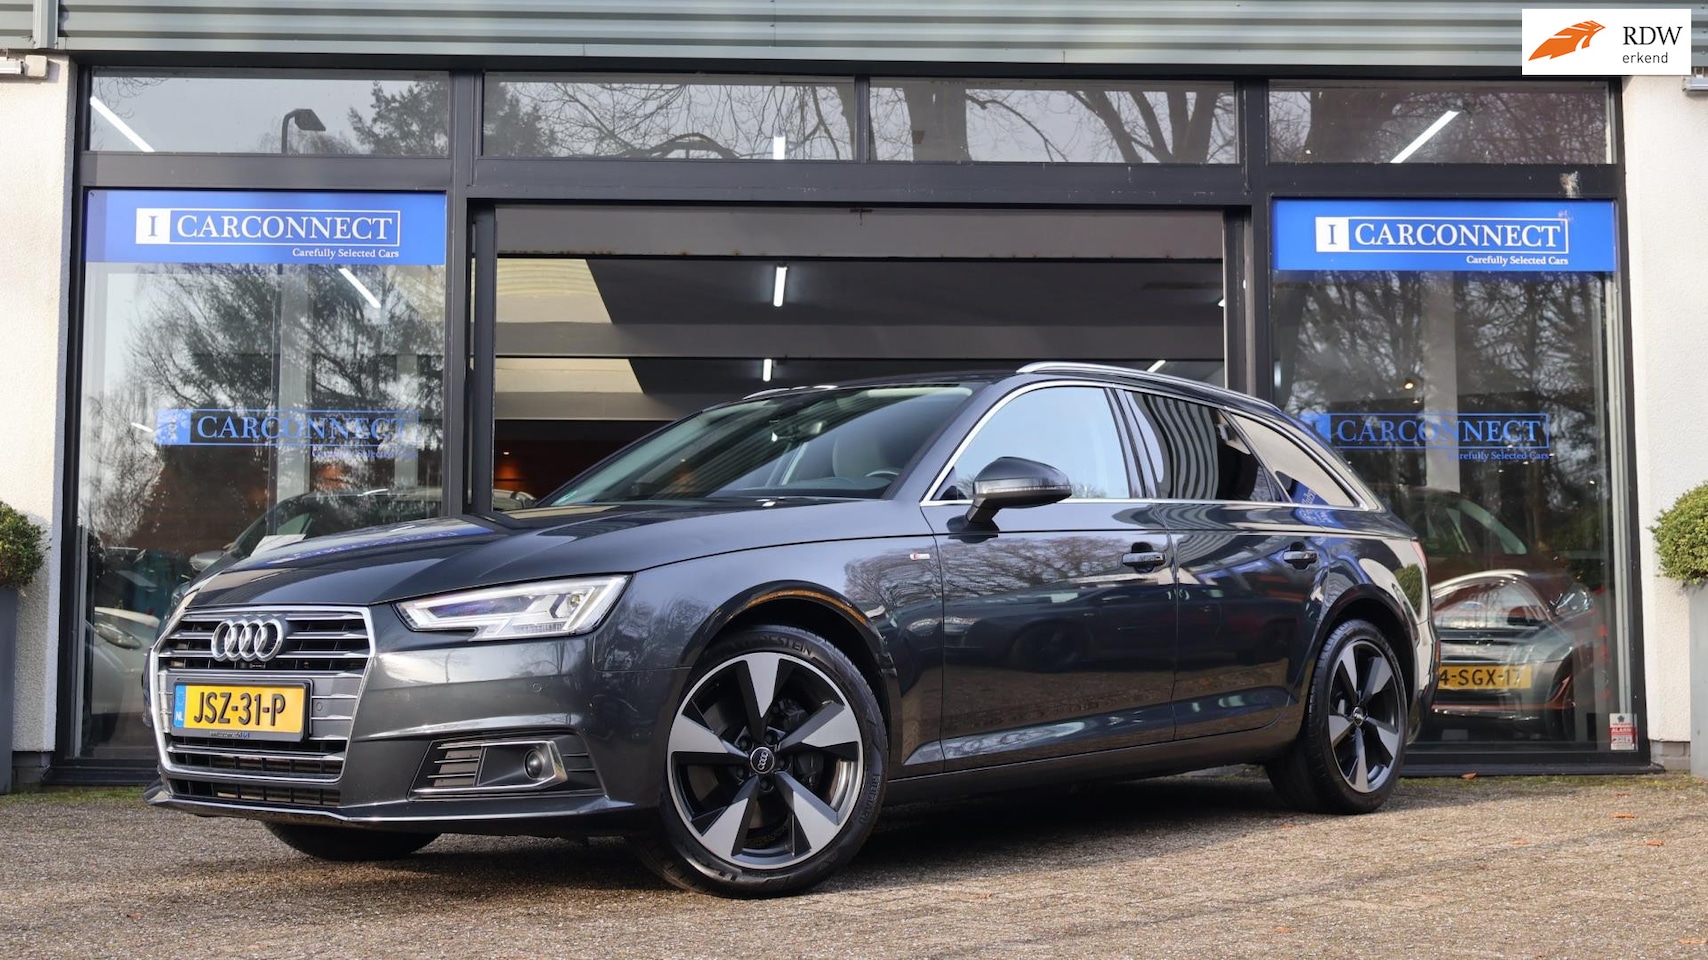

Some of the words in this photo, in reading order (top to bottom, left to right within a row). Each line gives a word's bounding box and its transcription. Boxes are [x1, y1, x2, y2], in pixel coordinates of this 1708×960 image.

[177, 215, 392, 240] CARCONNECT
[1354, 223, 1561, 248] CARCONNECT
[292, 248, 336, 259] Carefully
[338, 249, 377, 258] Selected
[378, 249, 399, 258] Cars
[1466, 255, 1508, 267] Carefully
[1509, 255, 1546, 265] Selected
[1548, 256, 1569, 265] Cars
[196, 415, 412, 440] CARCONNECT
[1337, 419, 1540, 443] CARCONNECT
[1491, 451, 1528, 460] Selected
[1529, 452, 1549, 460] Cars
[1439, 668, 1521, 686] 4-SGX-17
[175, 712, 184, 721] NL
[193, 691, 286, 726] JSZ-31-P
